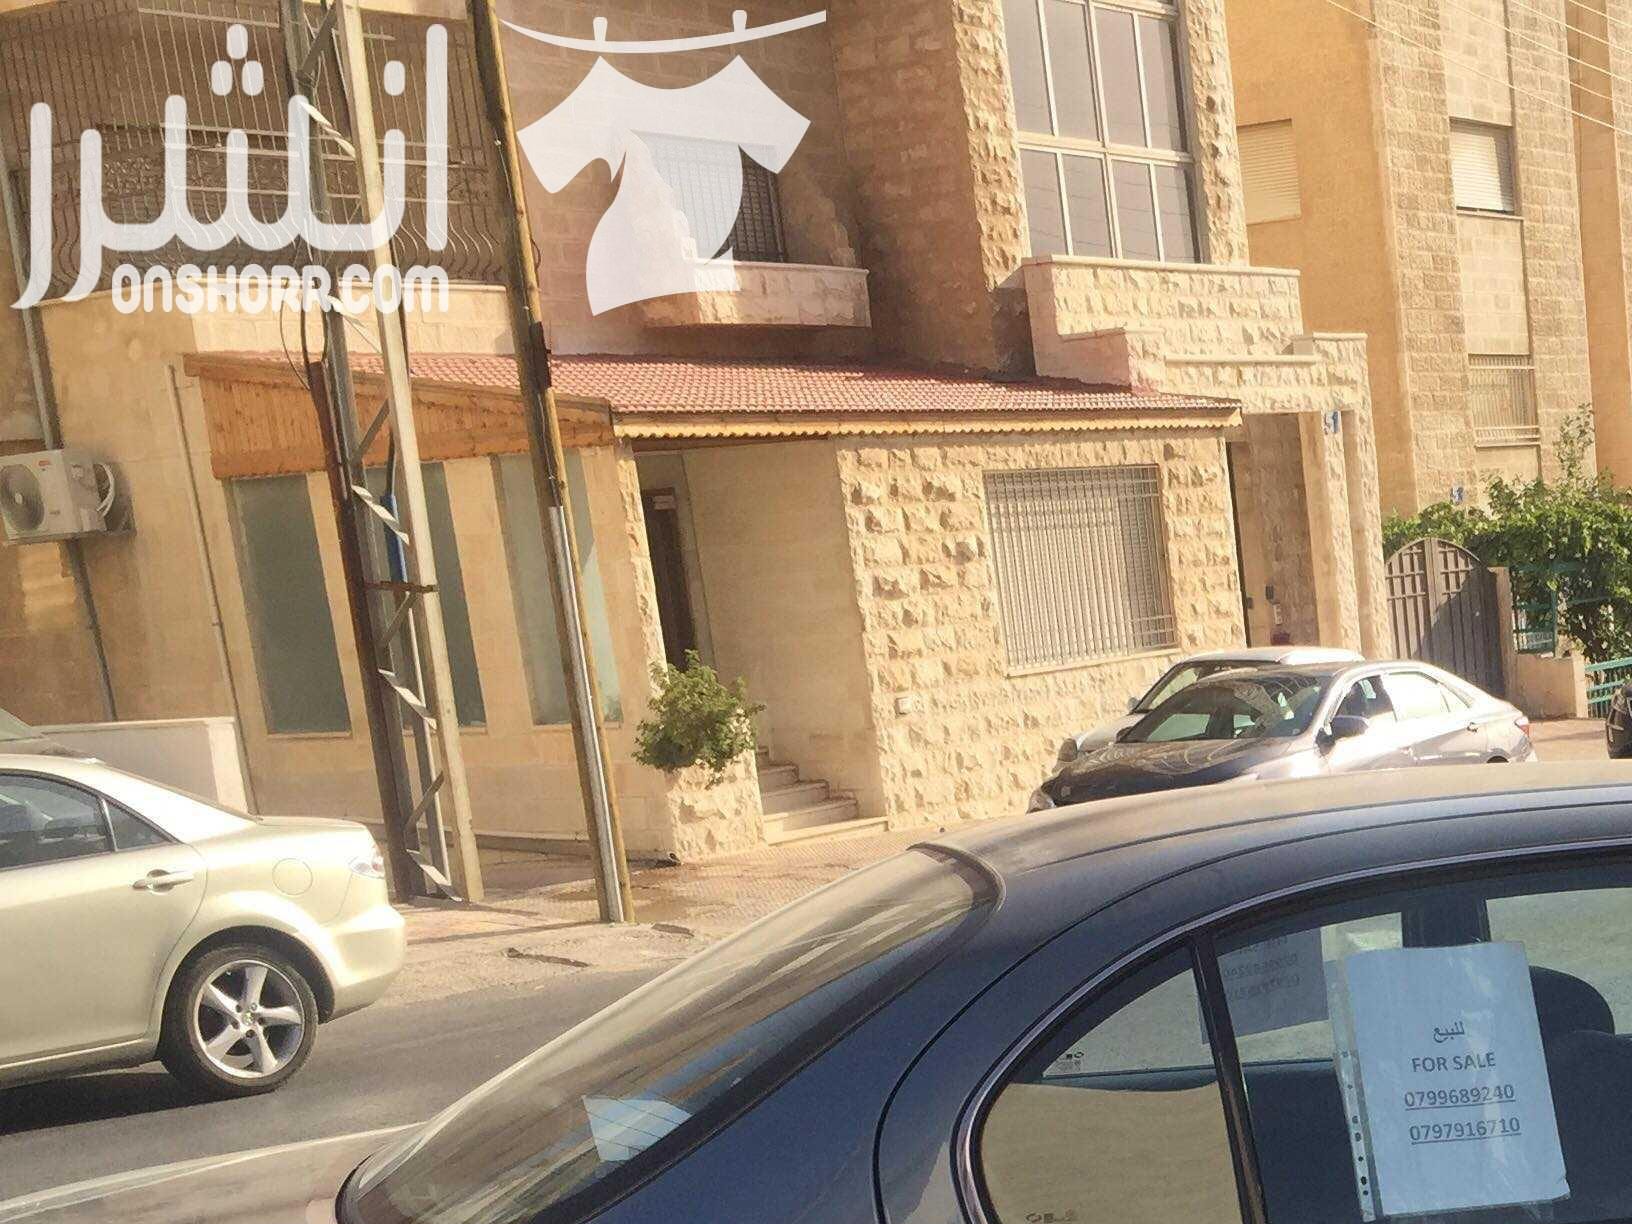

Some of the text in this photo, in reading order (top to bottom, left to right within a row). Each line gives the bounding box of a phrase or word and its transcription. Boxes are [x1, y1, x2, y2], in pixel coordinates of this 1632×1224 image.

[1433, 1020, 1465, 1043] للبيع
[1411, 1051, 1497, 1073] FOR SALE
[1409, 1117, 1521, 1141] 0797916710
